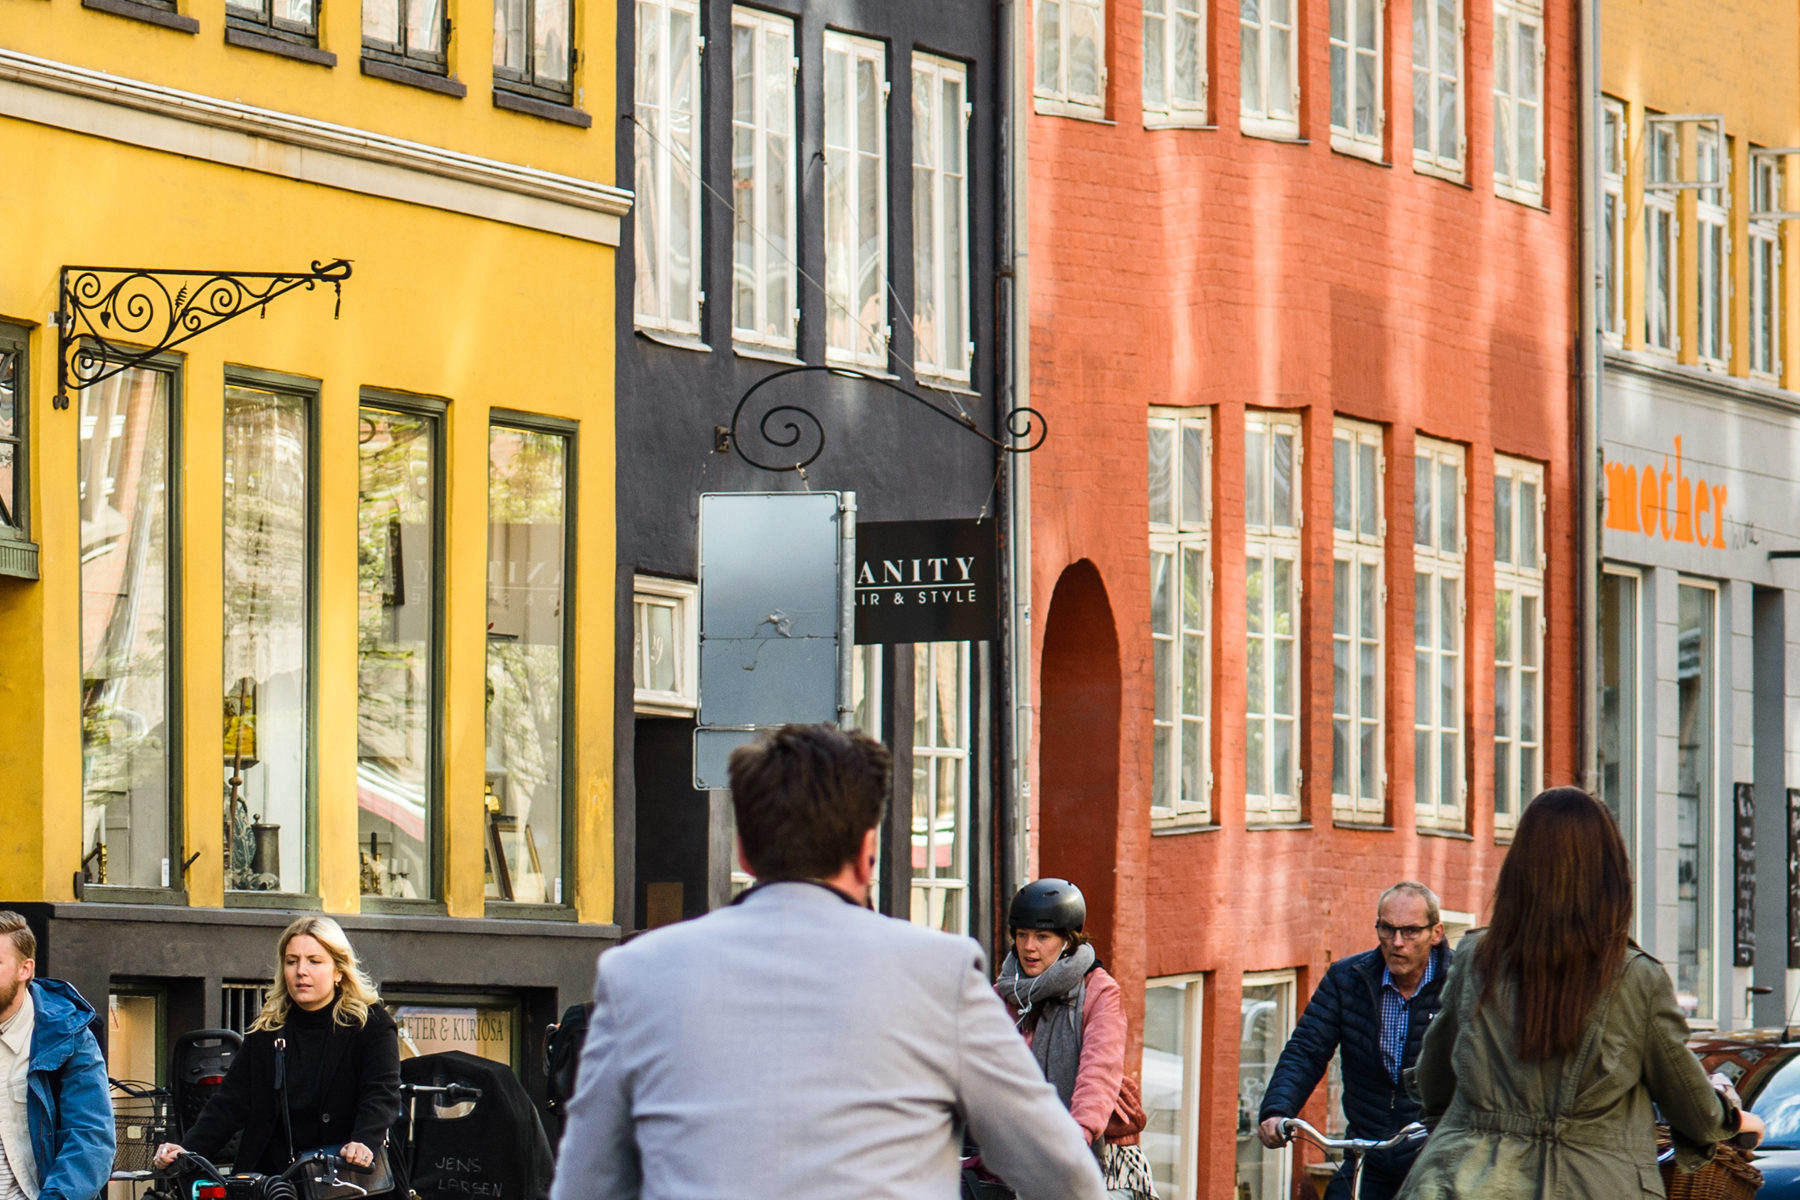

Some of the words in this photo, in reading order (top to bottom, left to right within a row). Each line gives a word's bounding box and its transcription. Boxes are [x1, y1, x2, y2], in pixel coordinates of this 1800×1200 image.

[1603, 434, 1728, 550] mother
[856, 556, 975, 585] ANITY
[854, 592, 880, 606] IR
[893, 591, 905, 605] &
[918, 589, 976, 604] STYLE
[439, 1017, 449, 1042] &
[453, 1018, 505, 1042] KURIOSA
[435, 1157, 482, 1173] JENS
